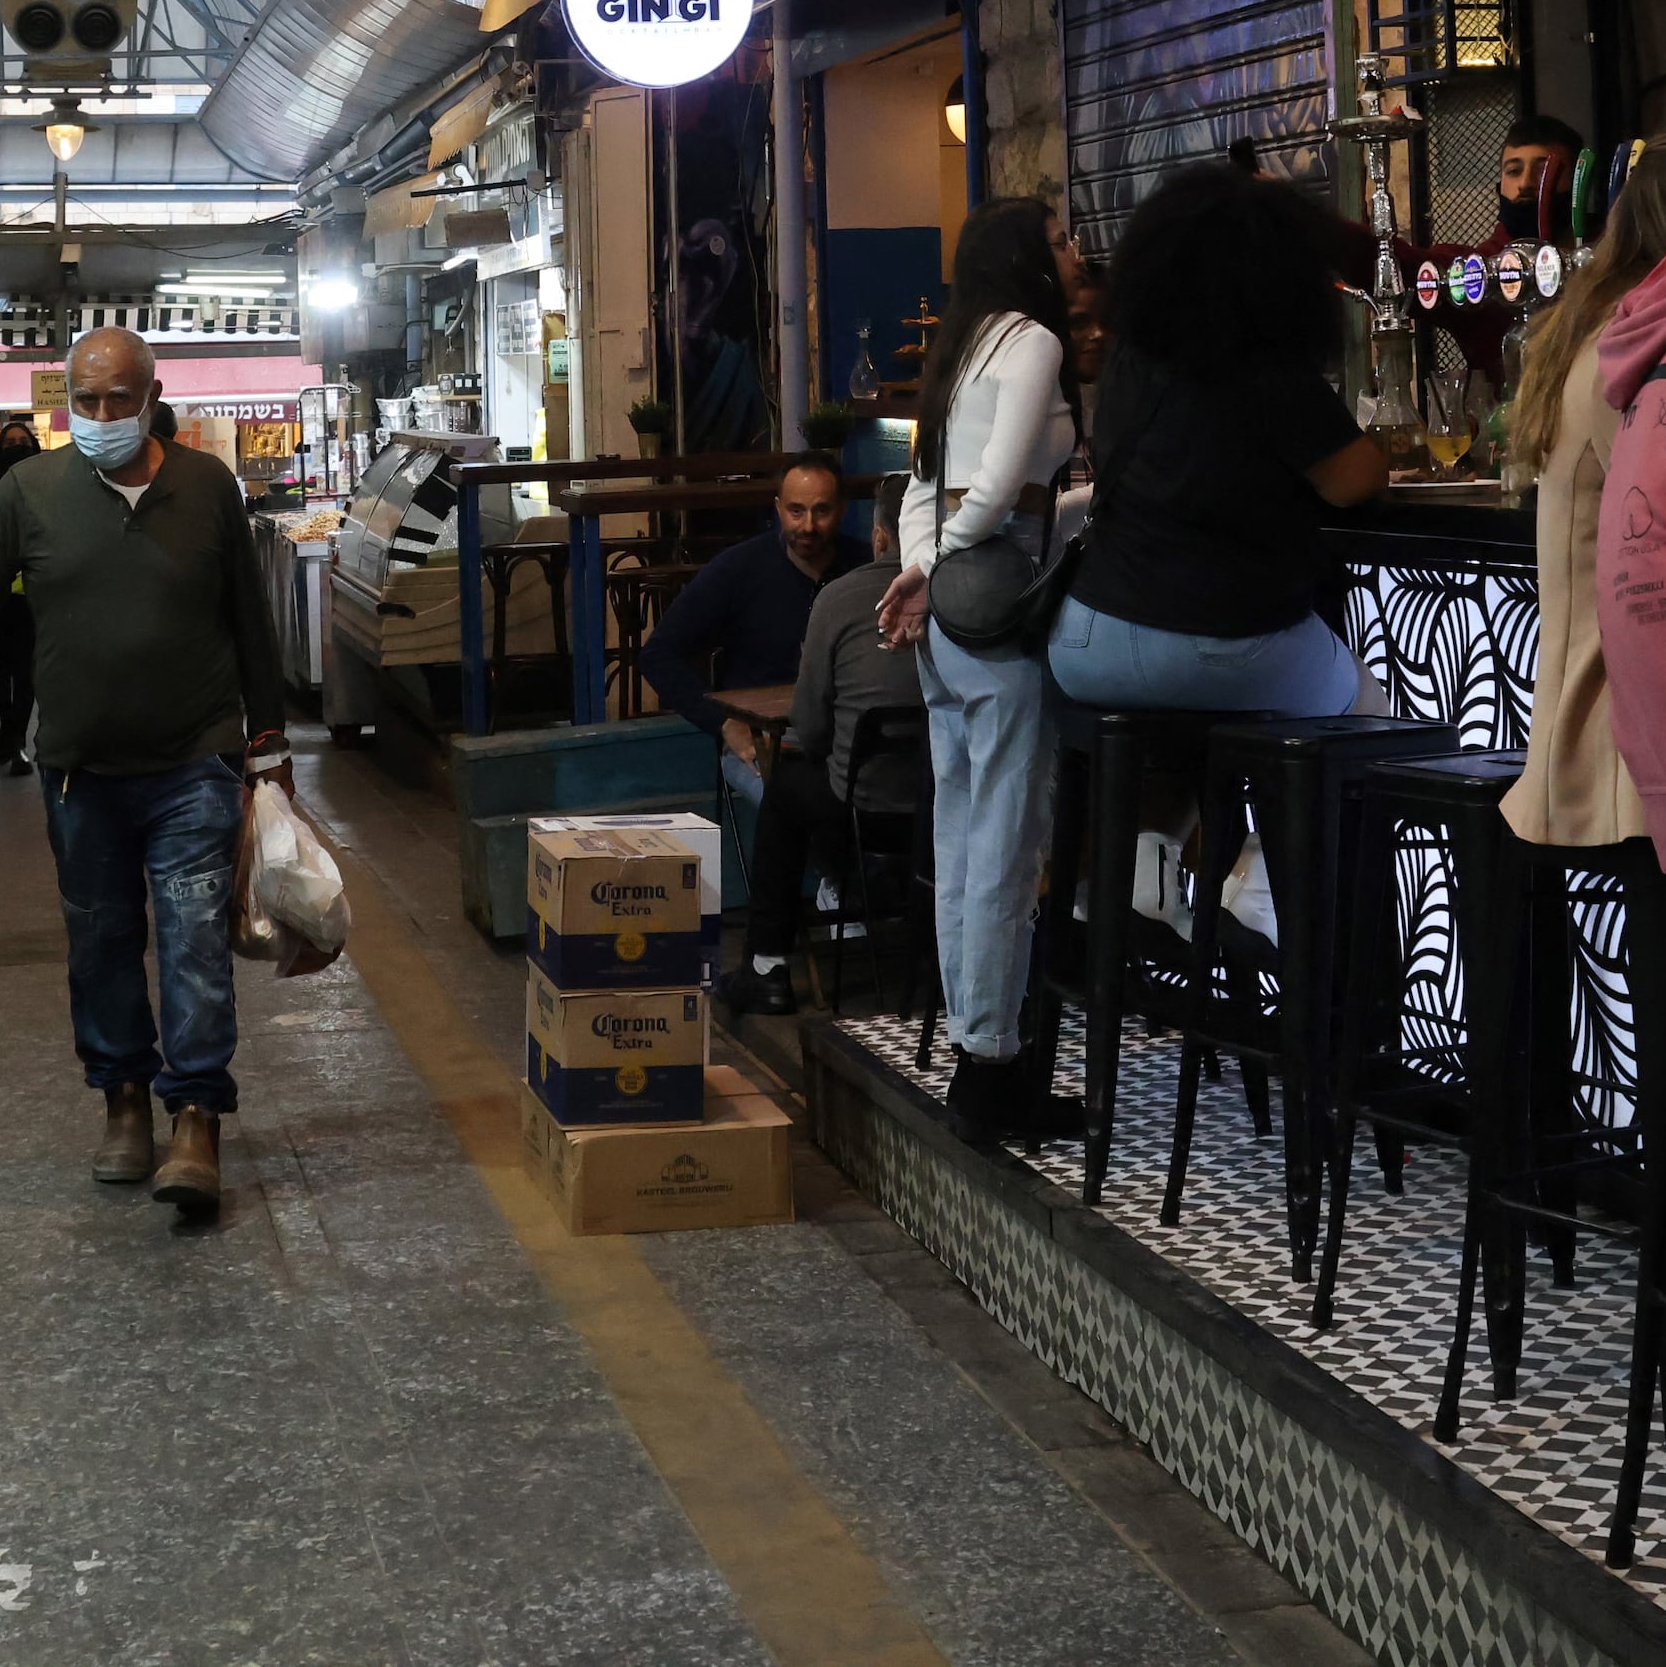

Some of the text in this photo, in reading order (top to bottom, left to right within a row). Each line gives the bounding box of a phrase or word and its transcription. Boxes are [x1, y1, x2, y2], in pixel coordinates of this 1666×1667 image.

[590, 880, 670, 908] Corona
[612, 902, 652, 917] Extra
[591, 1011, 671, 1040] Corona
[613, 1034, 653, 1050] Extra
